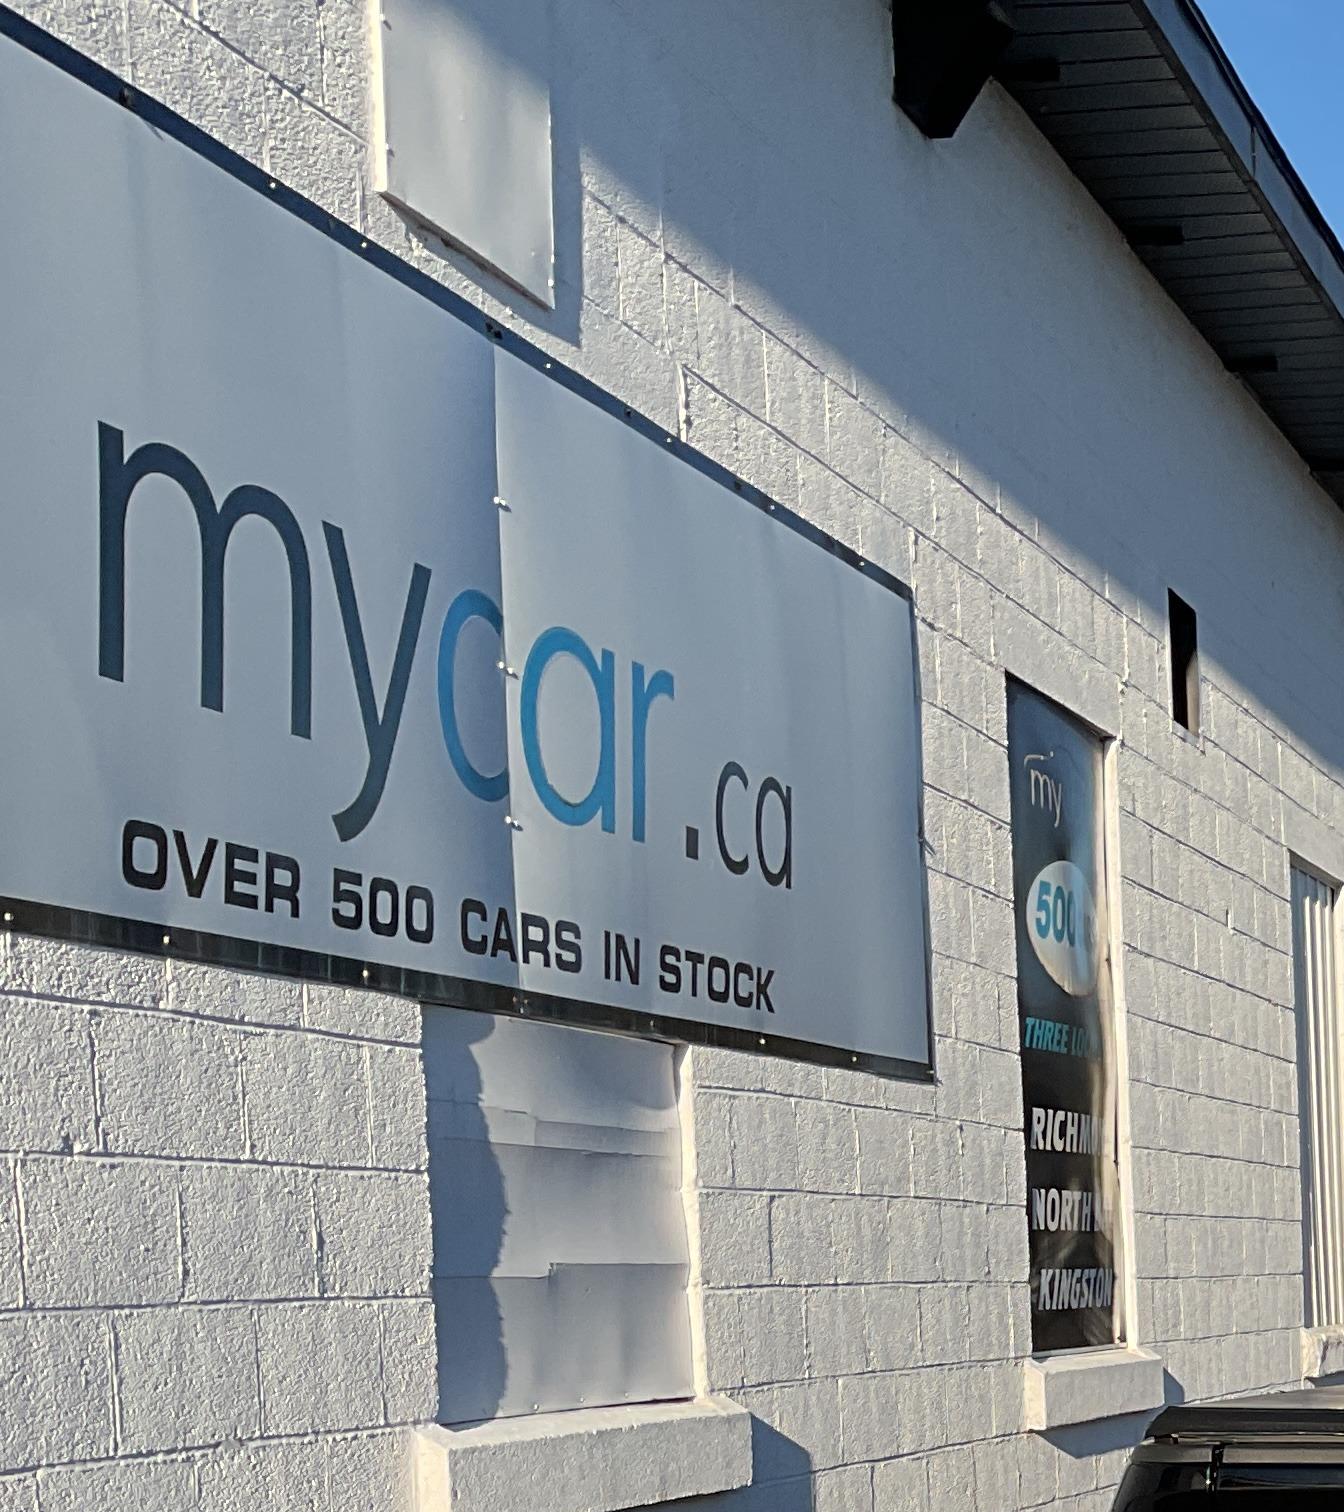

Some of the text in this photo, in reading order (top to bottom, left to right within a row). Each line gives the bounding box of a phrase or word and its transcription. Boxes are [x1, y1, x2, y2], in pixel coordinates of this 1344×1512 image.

[121, 818, 776, 1014] OVER 500 CARS IN STOCK
[1024, 1017, 1069, 1055] THREE
[1031, 1188, 1092, 1232] NORTH
[1038, 1268, 1113, 1311] KINGSTON
